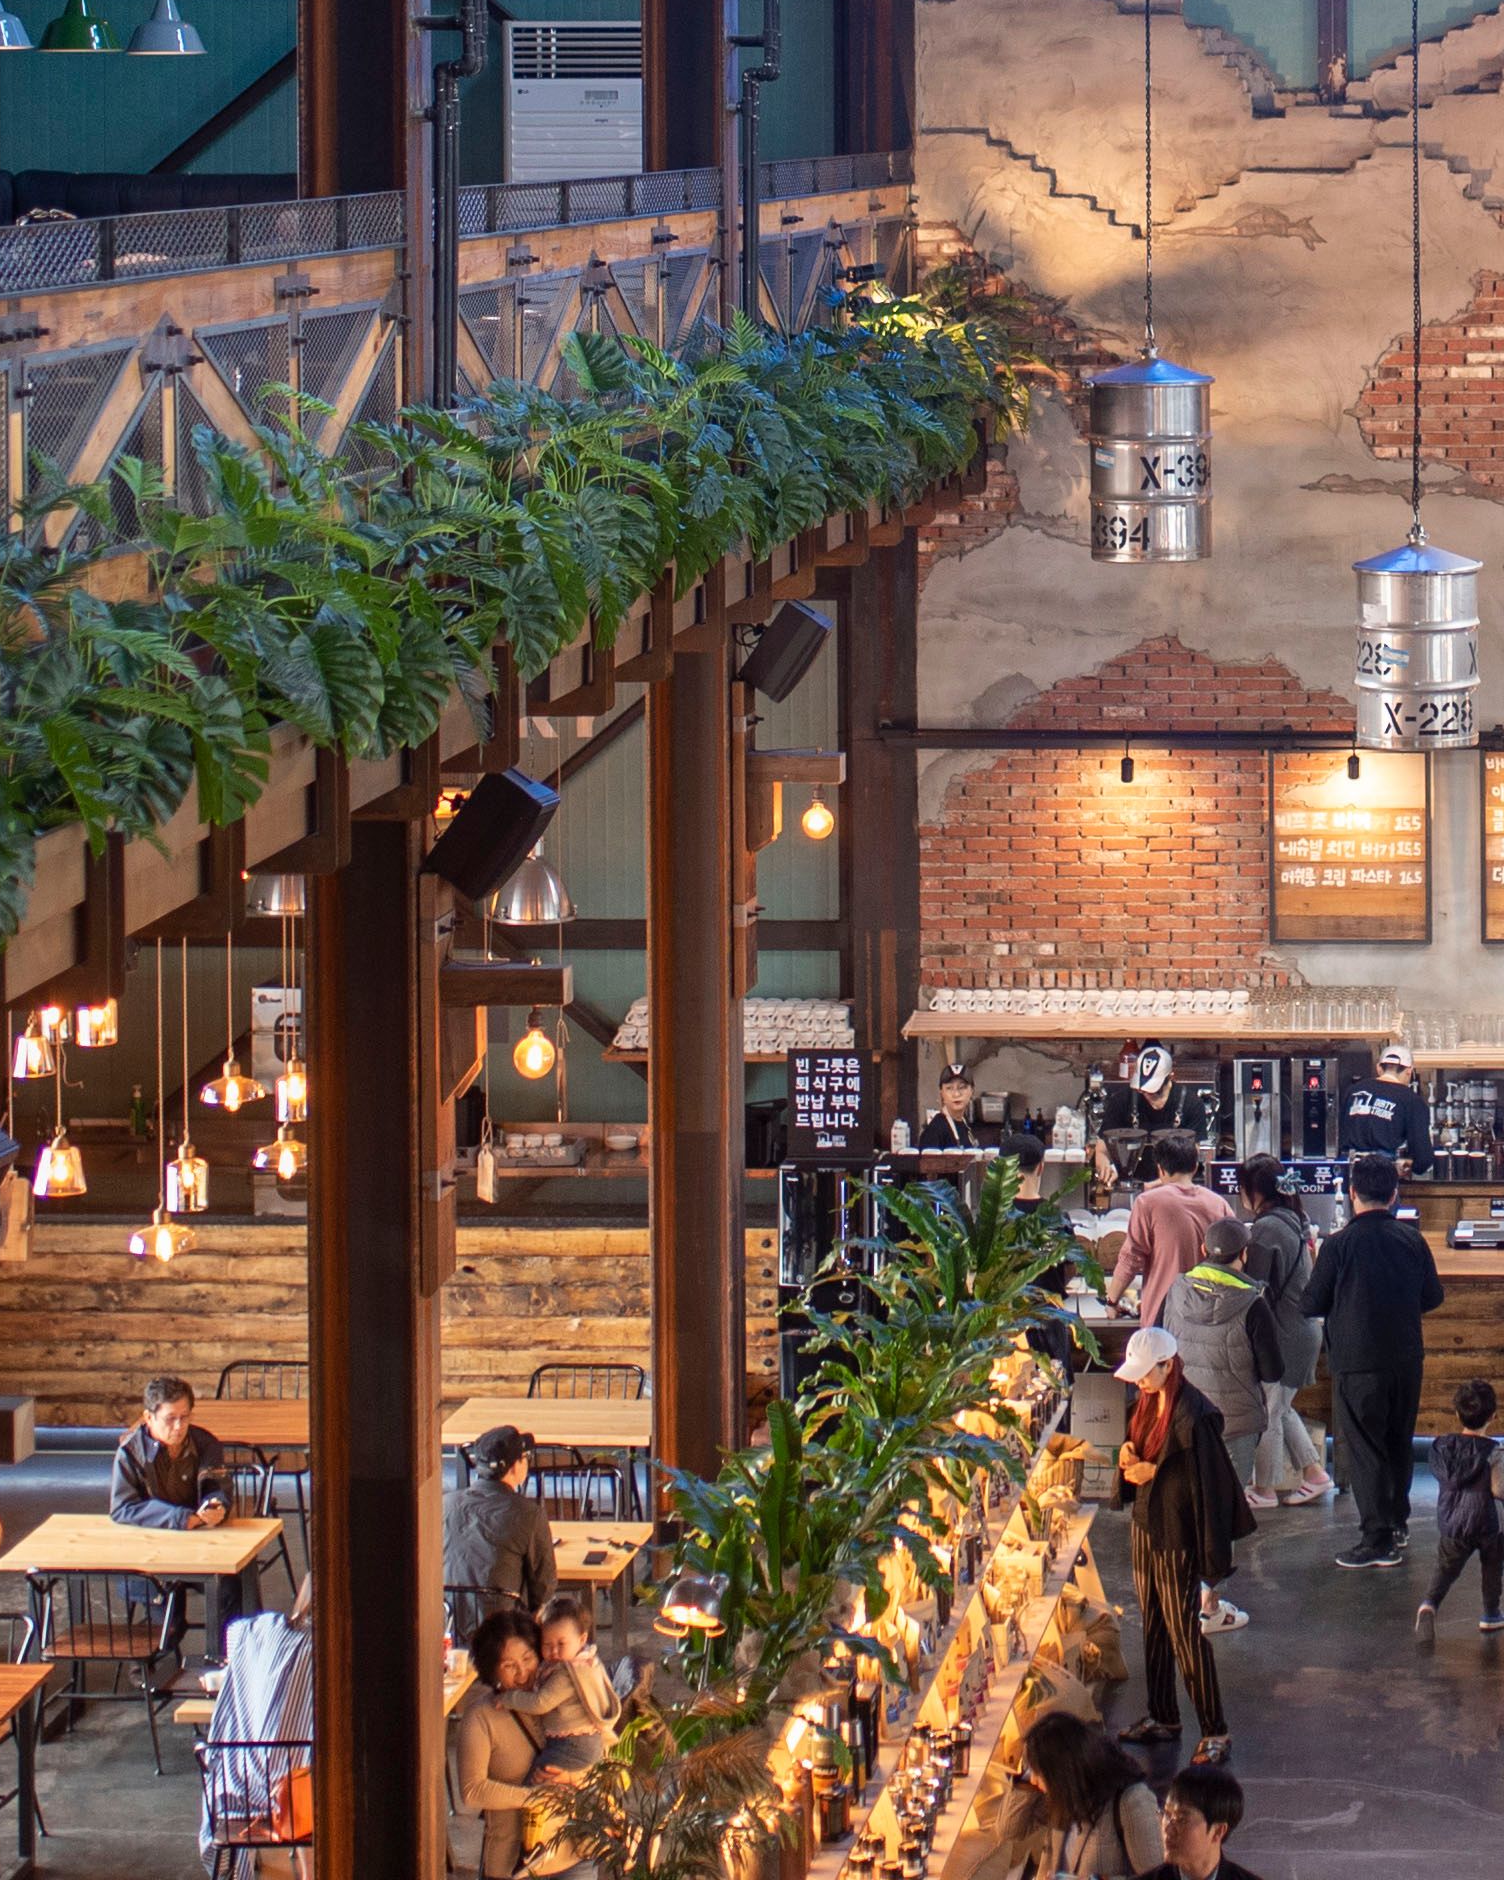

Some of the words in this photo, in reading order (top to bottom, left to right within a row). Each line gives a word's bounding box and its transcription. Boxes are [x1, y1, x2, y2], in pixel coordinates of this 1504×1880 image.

[1140, 453, 1210, 490] X-39
[1384, 699, 1473, 735] X-228
[1350, 868, 1392, 884] 파스타
[1399, 871, 1422, 884] 16.5
[795, 1057, 810, 1074] 빈
[815, 1058, 860, 1074] 그릇은
[795, 1094, 825, 1110] 반납
[830, 1094, 861, 1111] 부탁
[795, 1112, 859, 1128] 드립니다.
